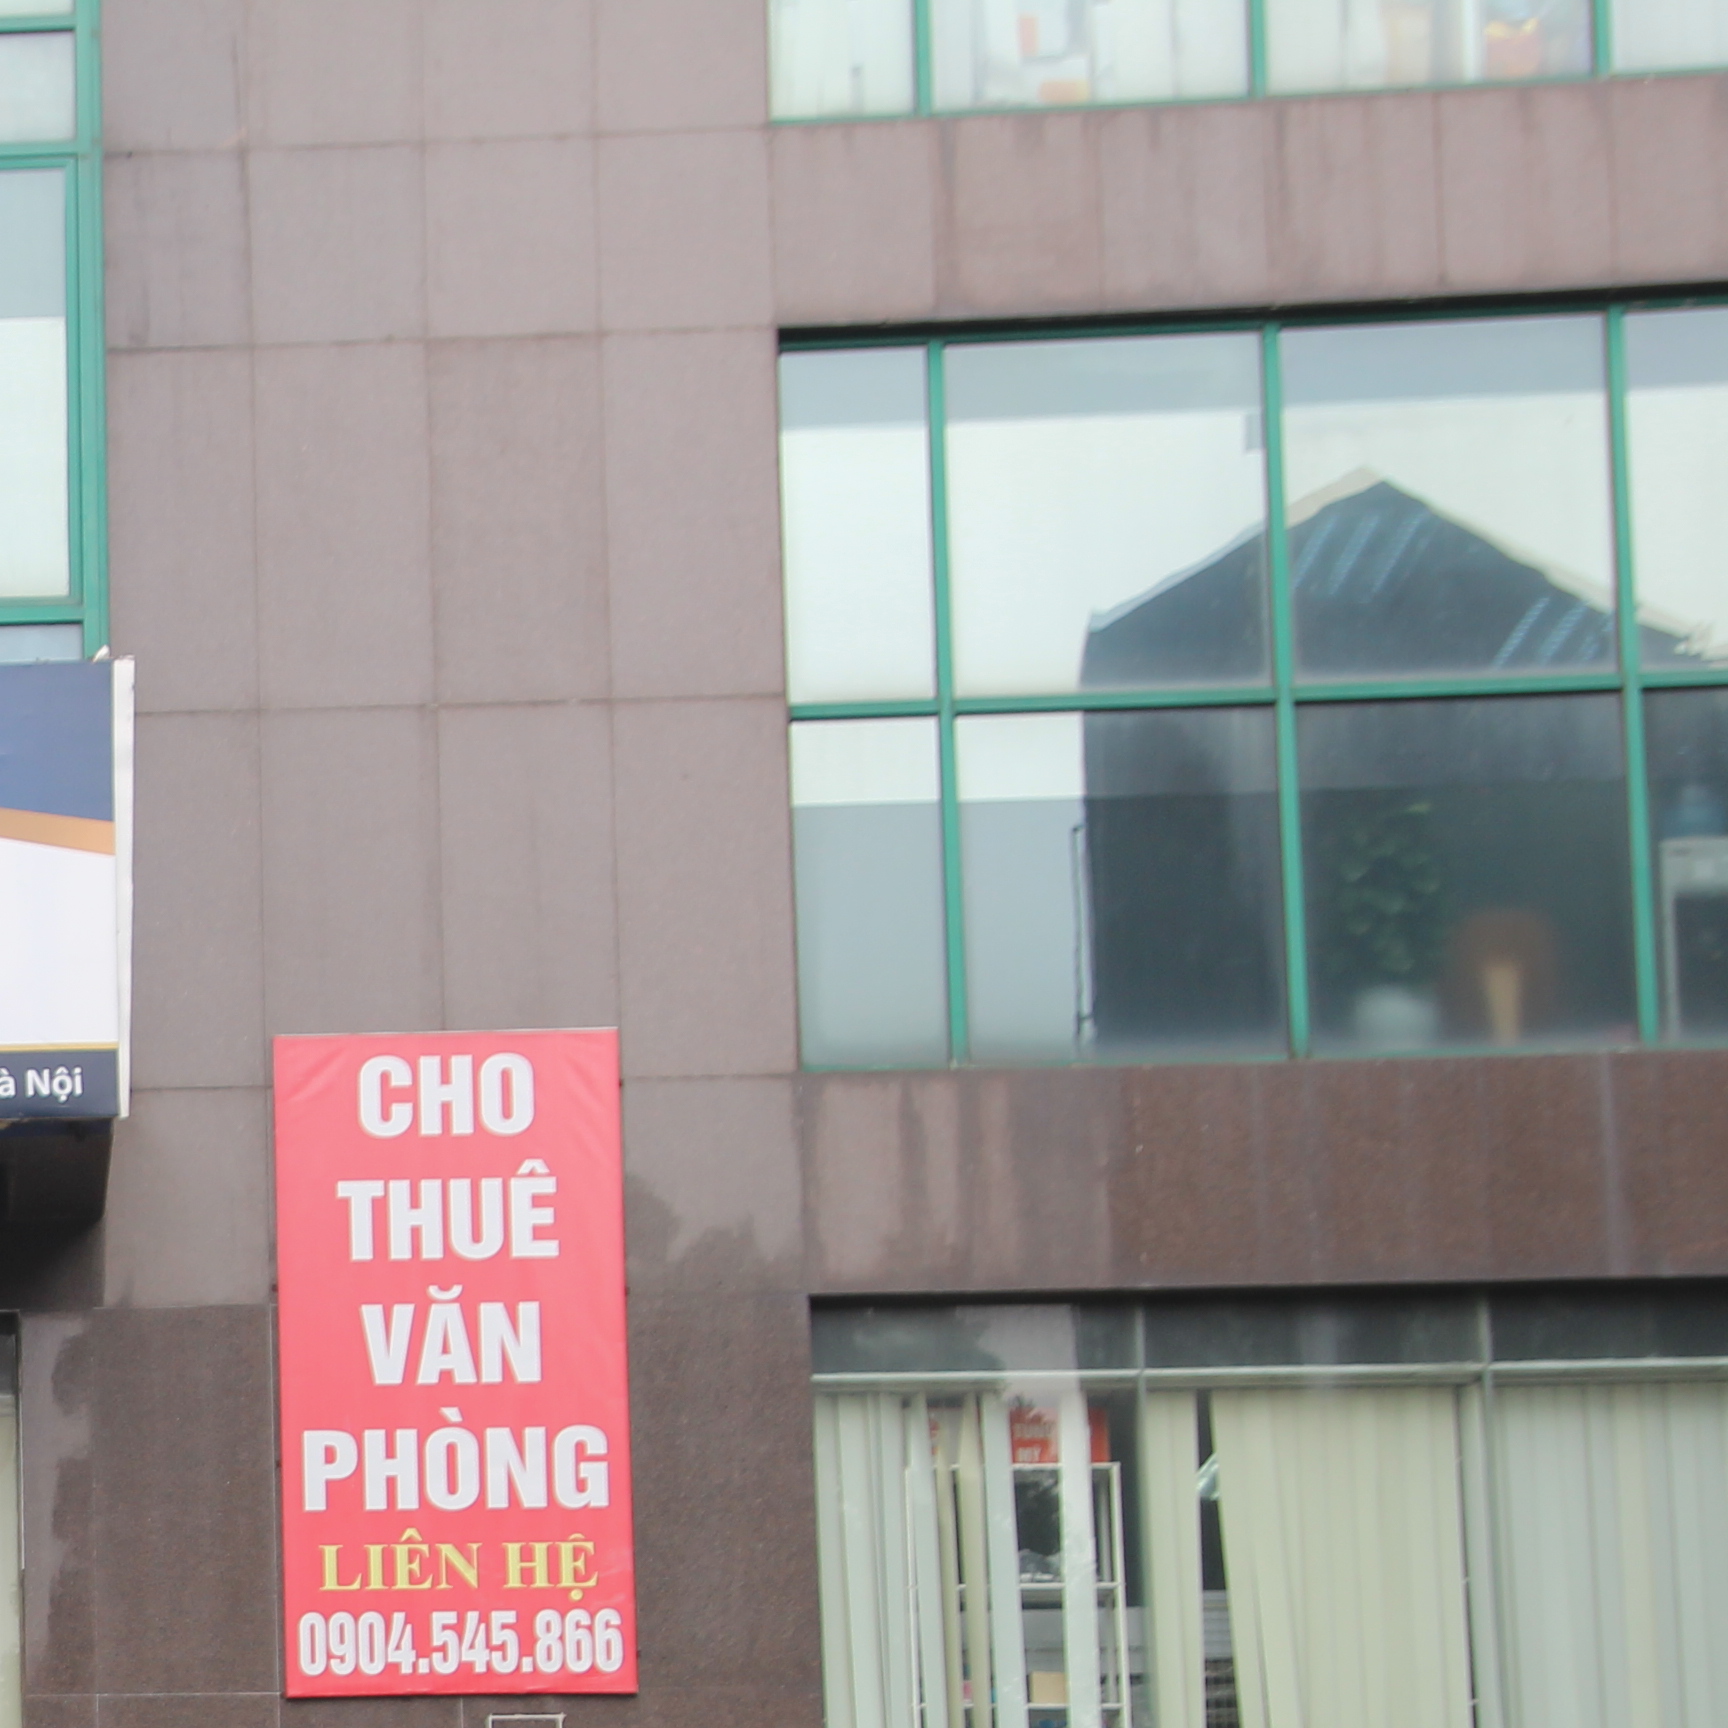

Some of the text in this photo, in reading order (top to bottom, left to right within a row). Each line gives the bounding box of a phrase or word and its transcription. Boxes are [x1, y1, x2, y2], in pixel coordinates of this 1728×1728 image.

[25, 1066, 83, 1102] Nội
[356, 1051, 536, 1140] CHO
[334, 1157, 560, 1263] THUÊ
[358, 1283, 542, 1386] VĂN
[301, 1406, 610, 1513] PHÒNG
[318, 1527, 599, 1602] LIÊN HỆ
[297, 1607, 624, 1677] 0904.545.866
